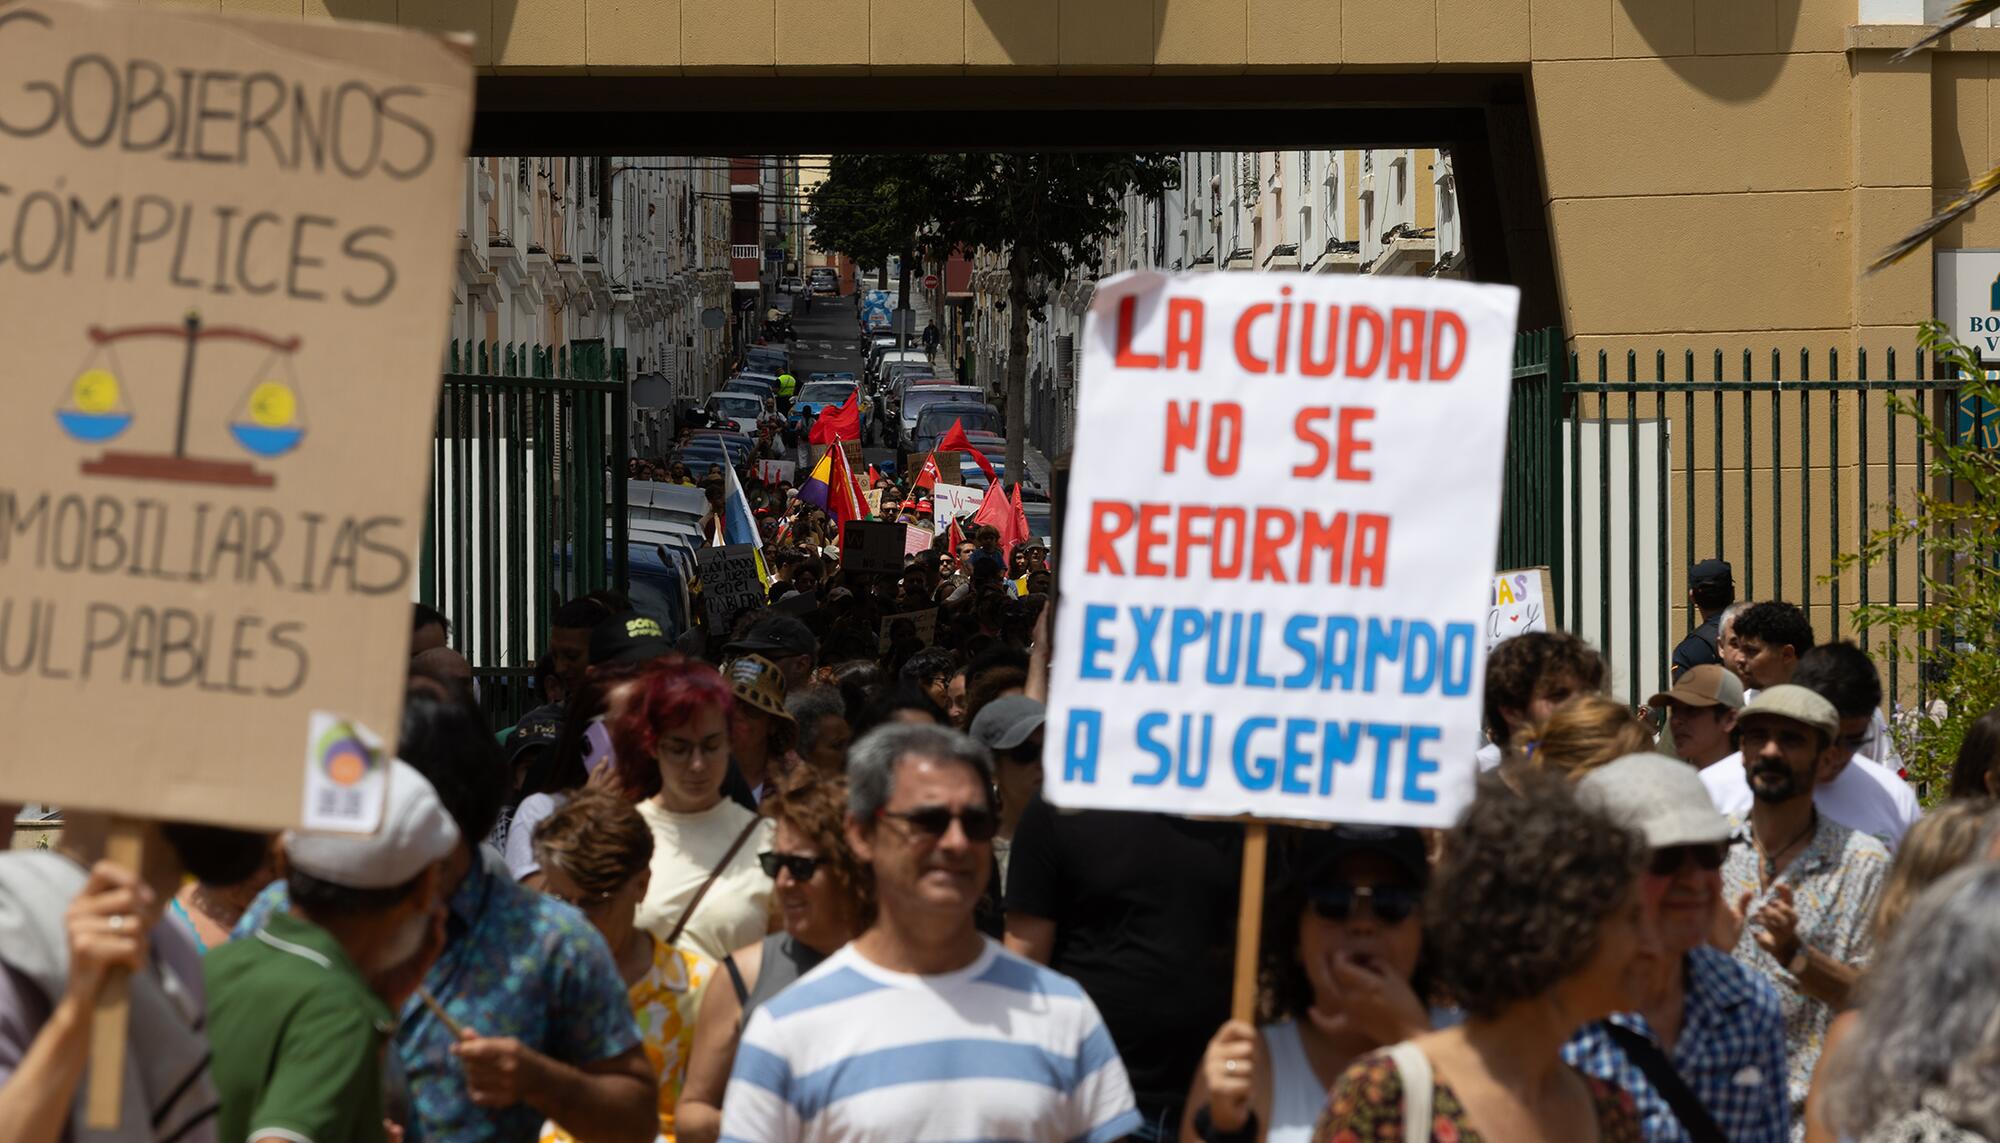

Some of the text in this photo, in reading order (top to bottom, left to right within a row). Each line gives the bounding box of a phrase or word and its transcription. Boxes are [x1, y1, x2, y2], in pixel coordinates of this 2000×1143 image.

[0, 9, 436, 180] GOBIERNOS
[0, 175, 398, 307] ÓMPLICES
[1114, 294, 1205, 371] LA
[1163, 400, 1375, 482] NO SE
[1087, 500, 1390, 588] REFORMA
[1079, 603, 1476, 697] EXPULSANDO
[1063, 708, 1442, 804] A SU GENTE
